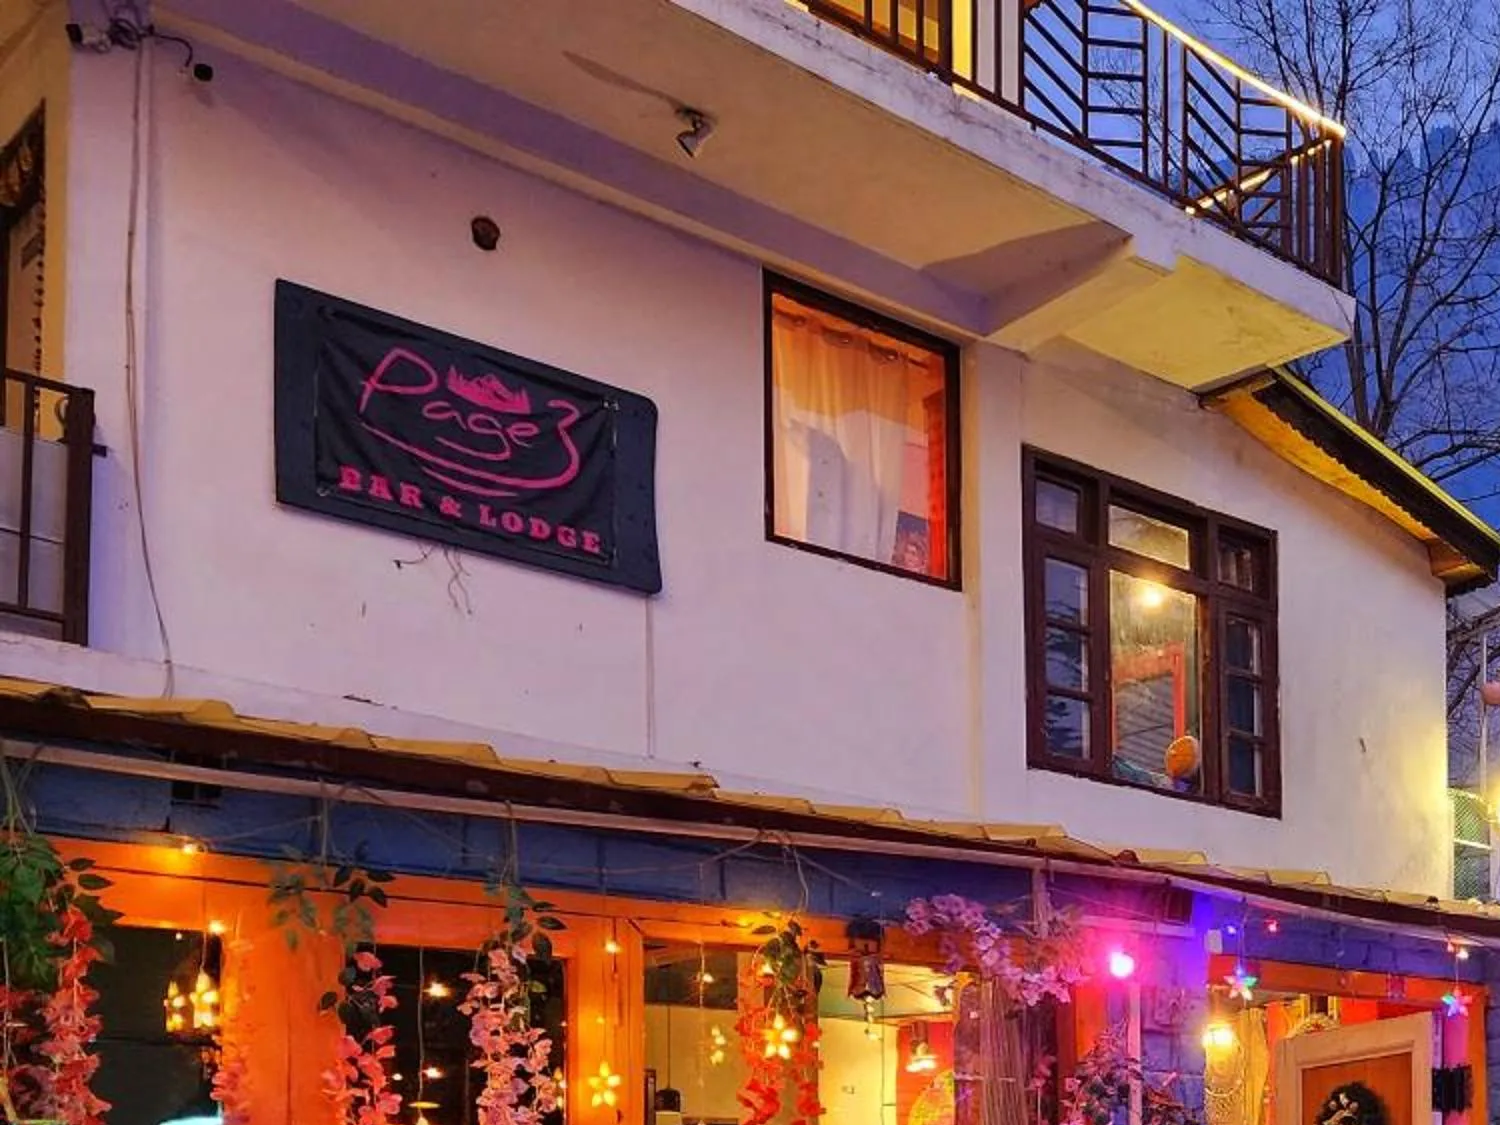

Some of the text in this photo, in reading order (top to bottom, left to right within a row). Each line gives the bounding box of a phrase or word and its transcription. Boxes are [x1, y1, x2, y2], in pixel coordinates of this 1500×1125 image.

[339, 464, 601, 554] BAR & LODGE
